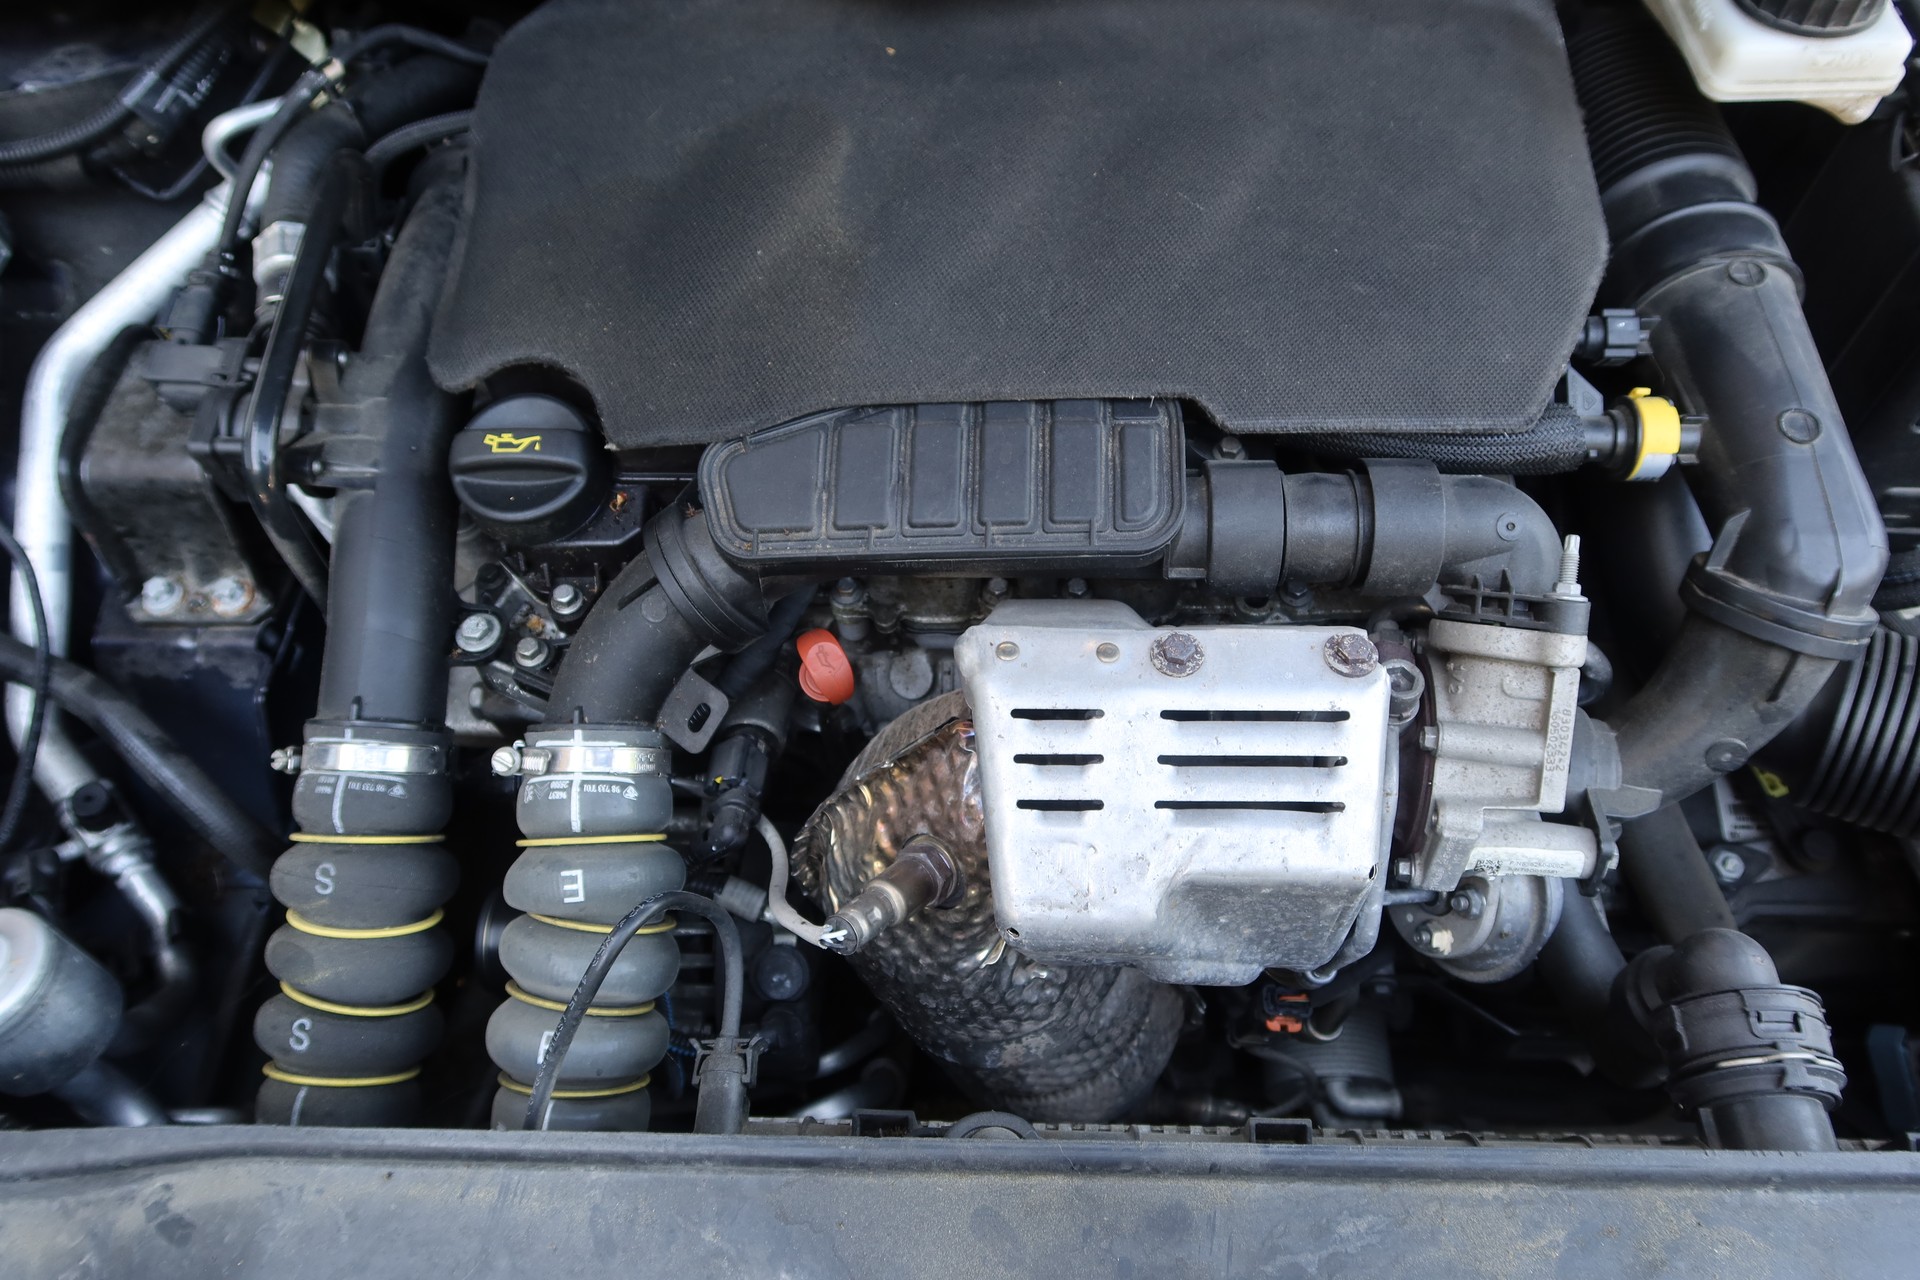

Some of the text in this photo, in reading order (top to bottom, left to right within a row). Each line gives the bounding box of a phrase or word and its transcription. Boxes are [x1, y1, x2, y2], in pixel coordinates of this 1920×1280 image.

[314, 861, 337, 895] S
[560, 869, 585, 904] E
[288, 1017, 312, 1052] S
